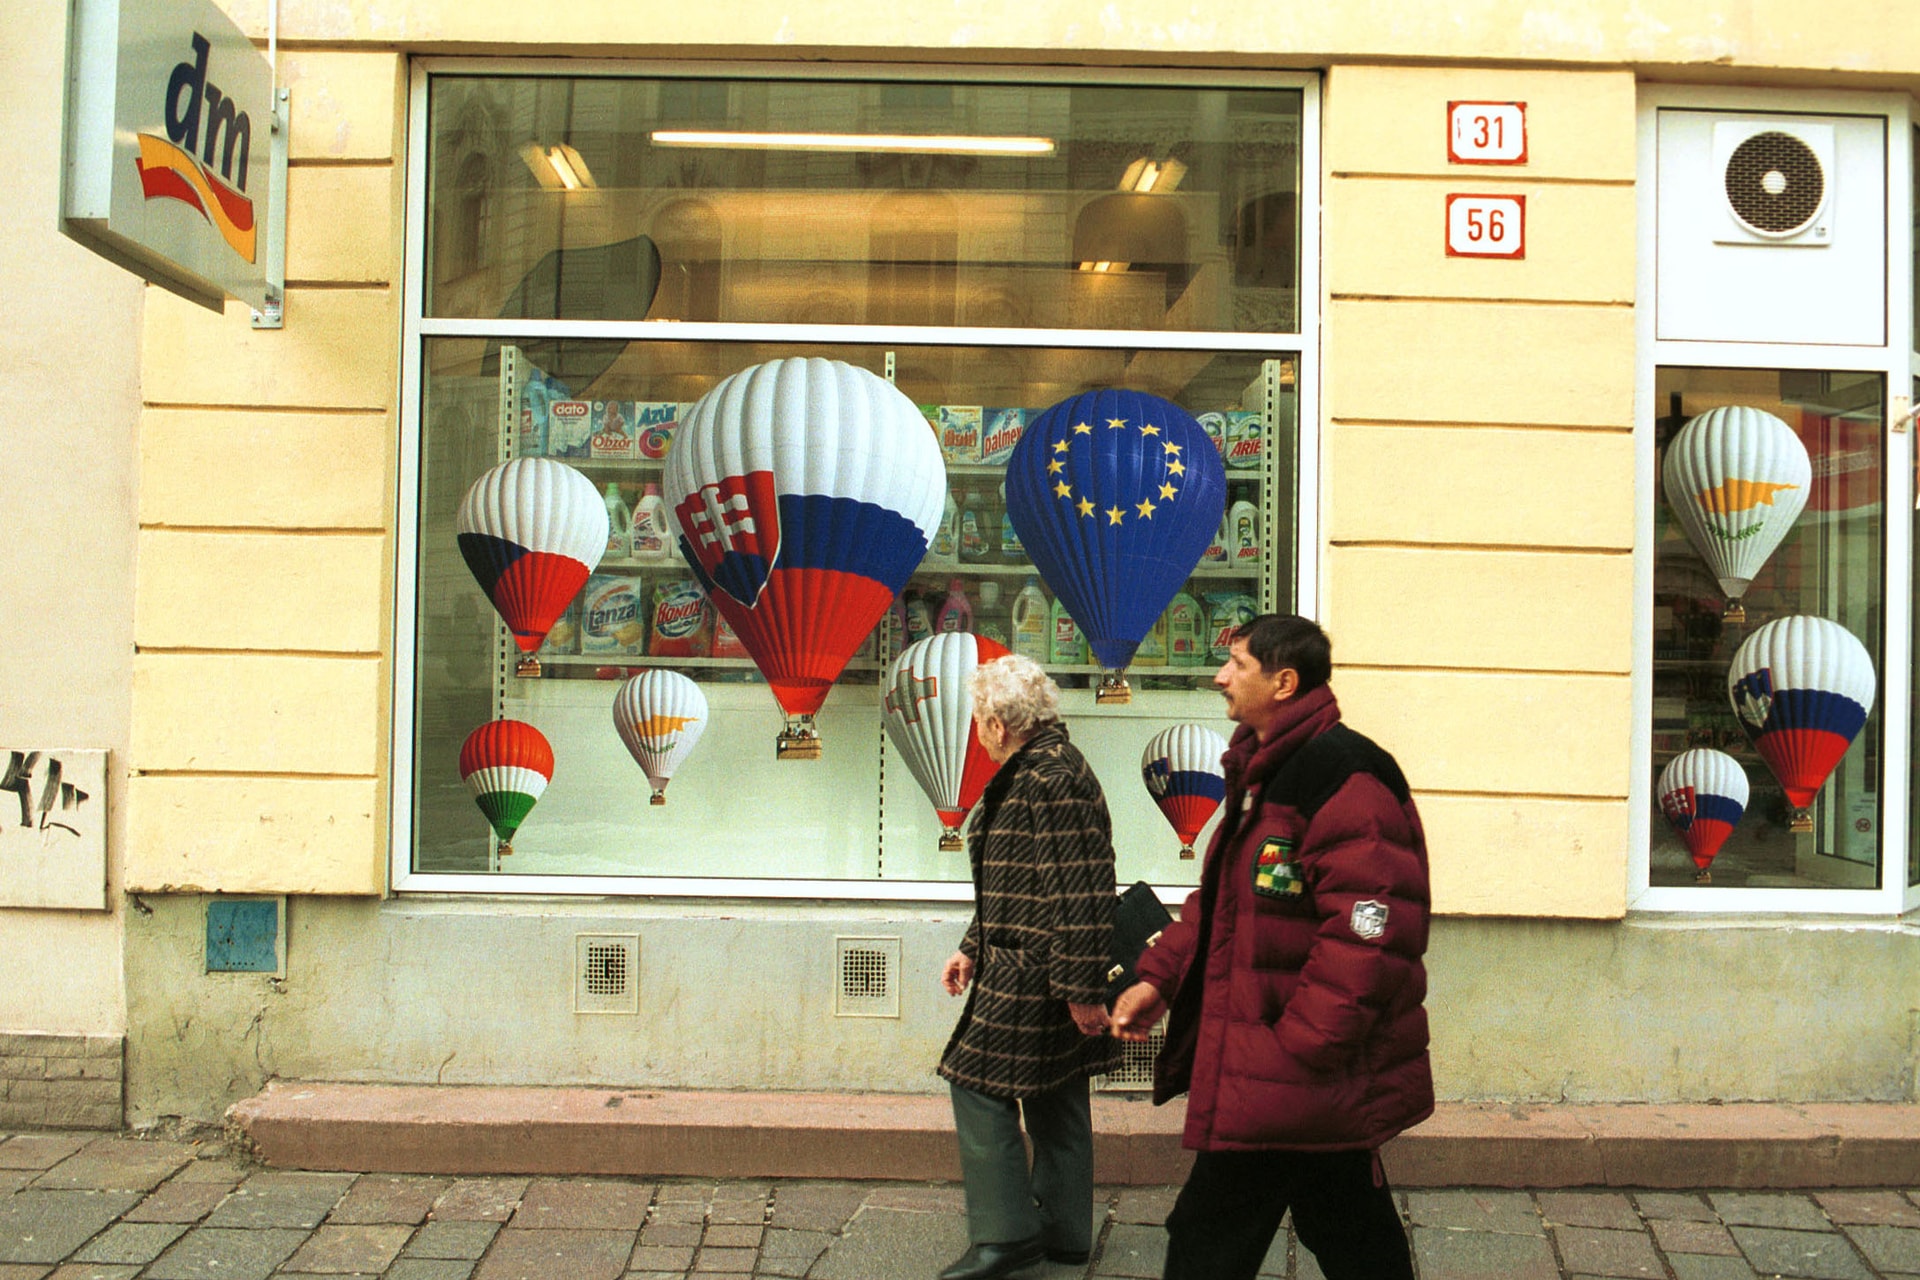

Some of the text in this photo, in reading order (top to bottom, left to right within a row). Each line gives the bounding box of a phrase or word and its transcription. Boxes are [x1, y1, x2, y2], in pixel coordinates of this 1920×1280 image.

[165, 31, 251, 193] dm
[1473, 115, 1504, 149] 31
[1467, 208, 1505, 242] 56
[556, 404, 585, 415] dato
[1230, 438, 1261, 458] ARIE
[588, 603, 636, 632] Lanza
